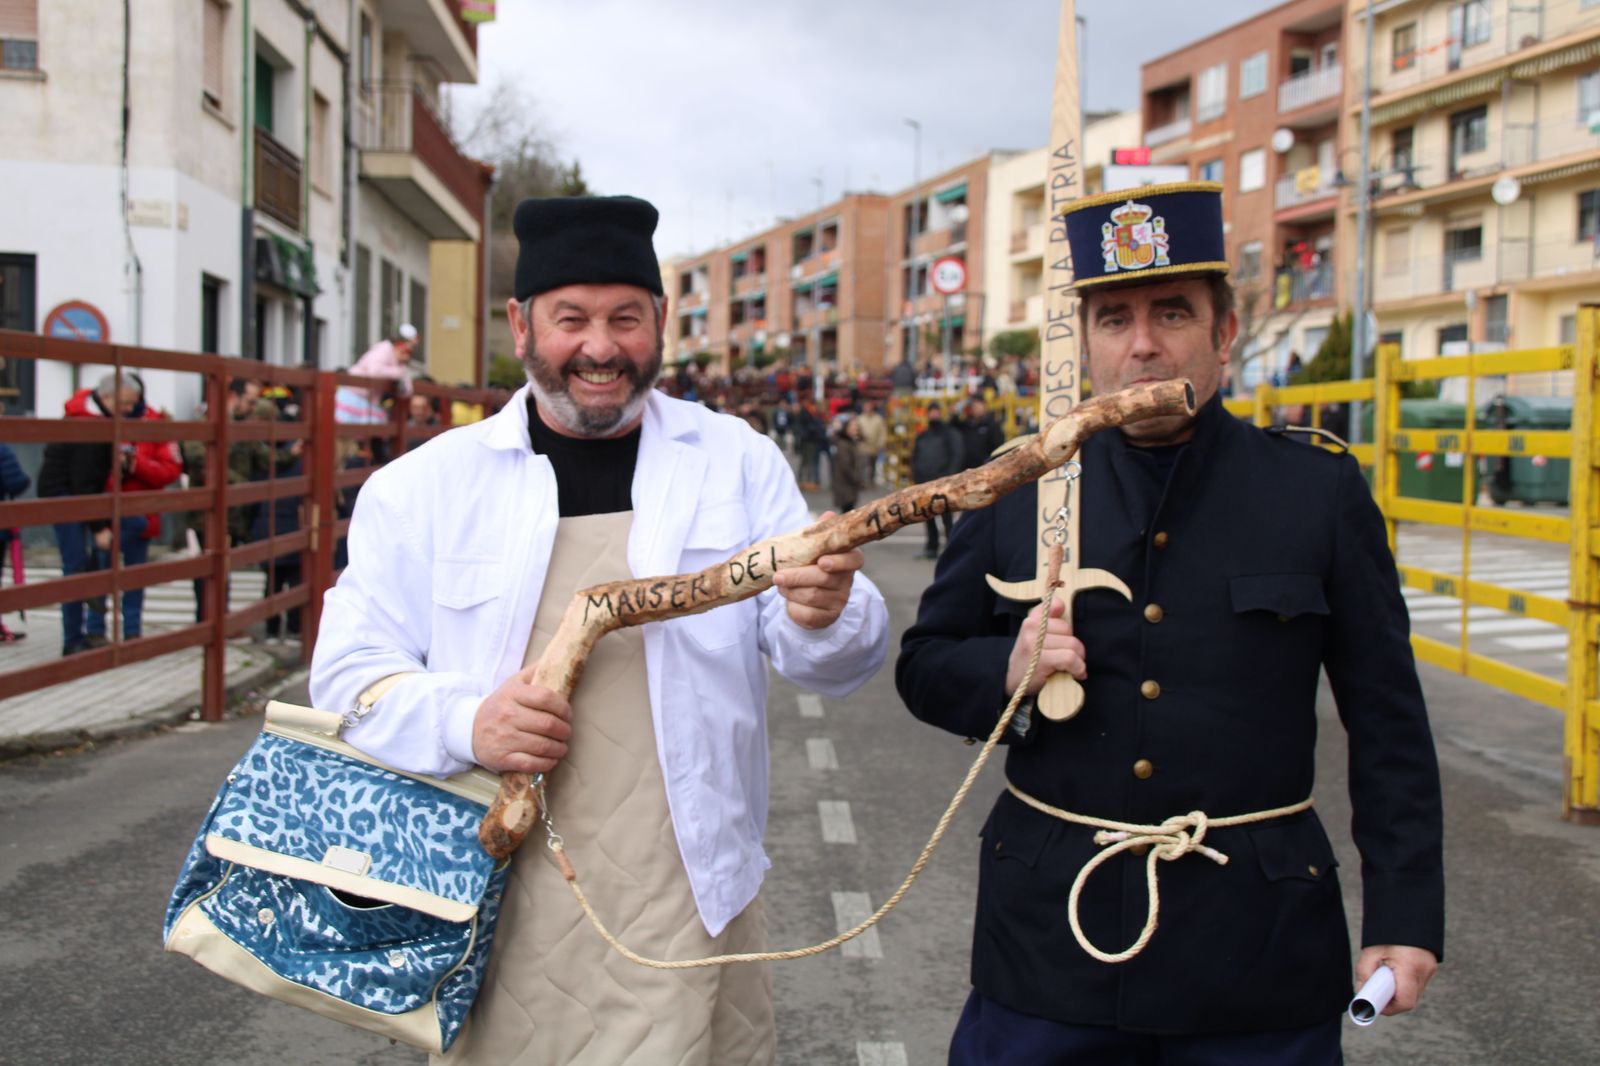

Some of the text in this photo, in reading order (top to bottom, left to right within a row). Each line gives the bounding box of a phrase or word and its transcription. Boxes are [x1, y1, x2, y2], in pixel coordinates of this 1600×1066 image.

[1048, 255, 1075, 291] LA
[1046, 301, 1075, 343] DE
[582, 573, 708, 626] MAUSER
[866, 493, 949, 534] 1940
